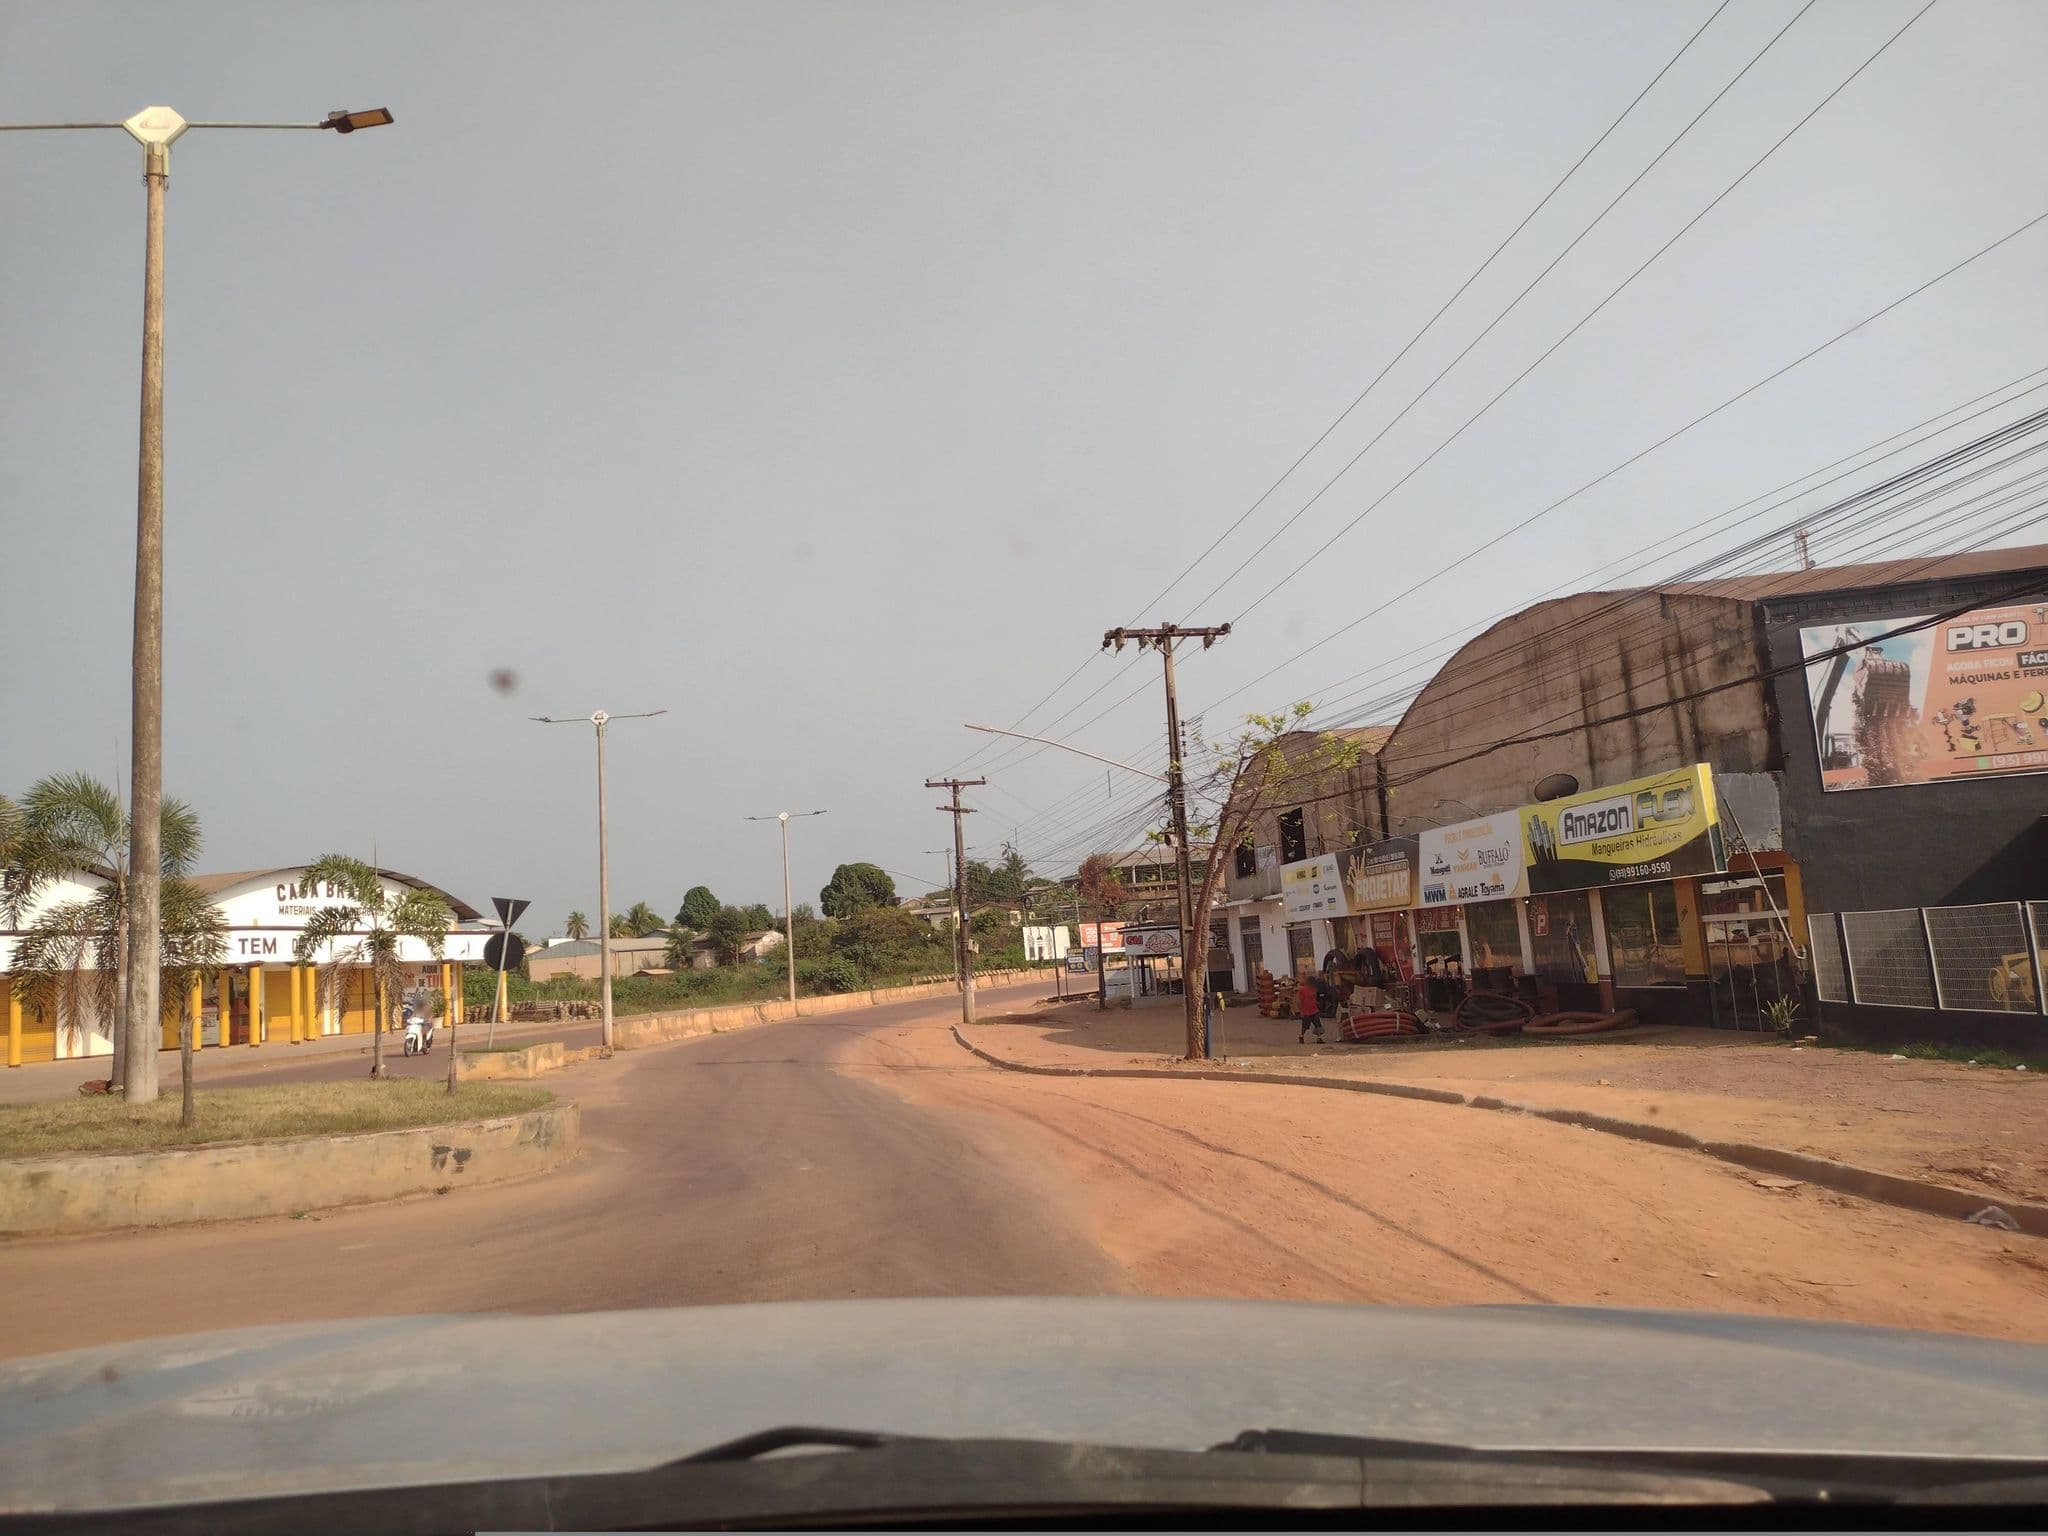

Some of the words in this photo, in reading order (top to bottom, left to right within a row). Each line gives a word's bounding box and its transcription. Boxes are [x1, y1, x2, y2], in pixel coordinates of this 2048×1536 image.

[1947, 621, 2027, 651] PRO
[2013, 670, 2020, 679] E
[1477, 846, 1509, 866] BUFFALO
[1591, 838, 1635, 857] Mangueiras
[1424, 888, 1447, 904] MWM
[238, 937, 278, 955] TEM
